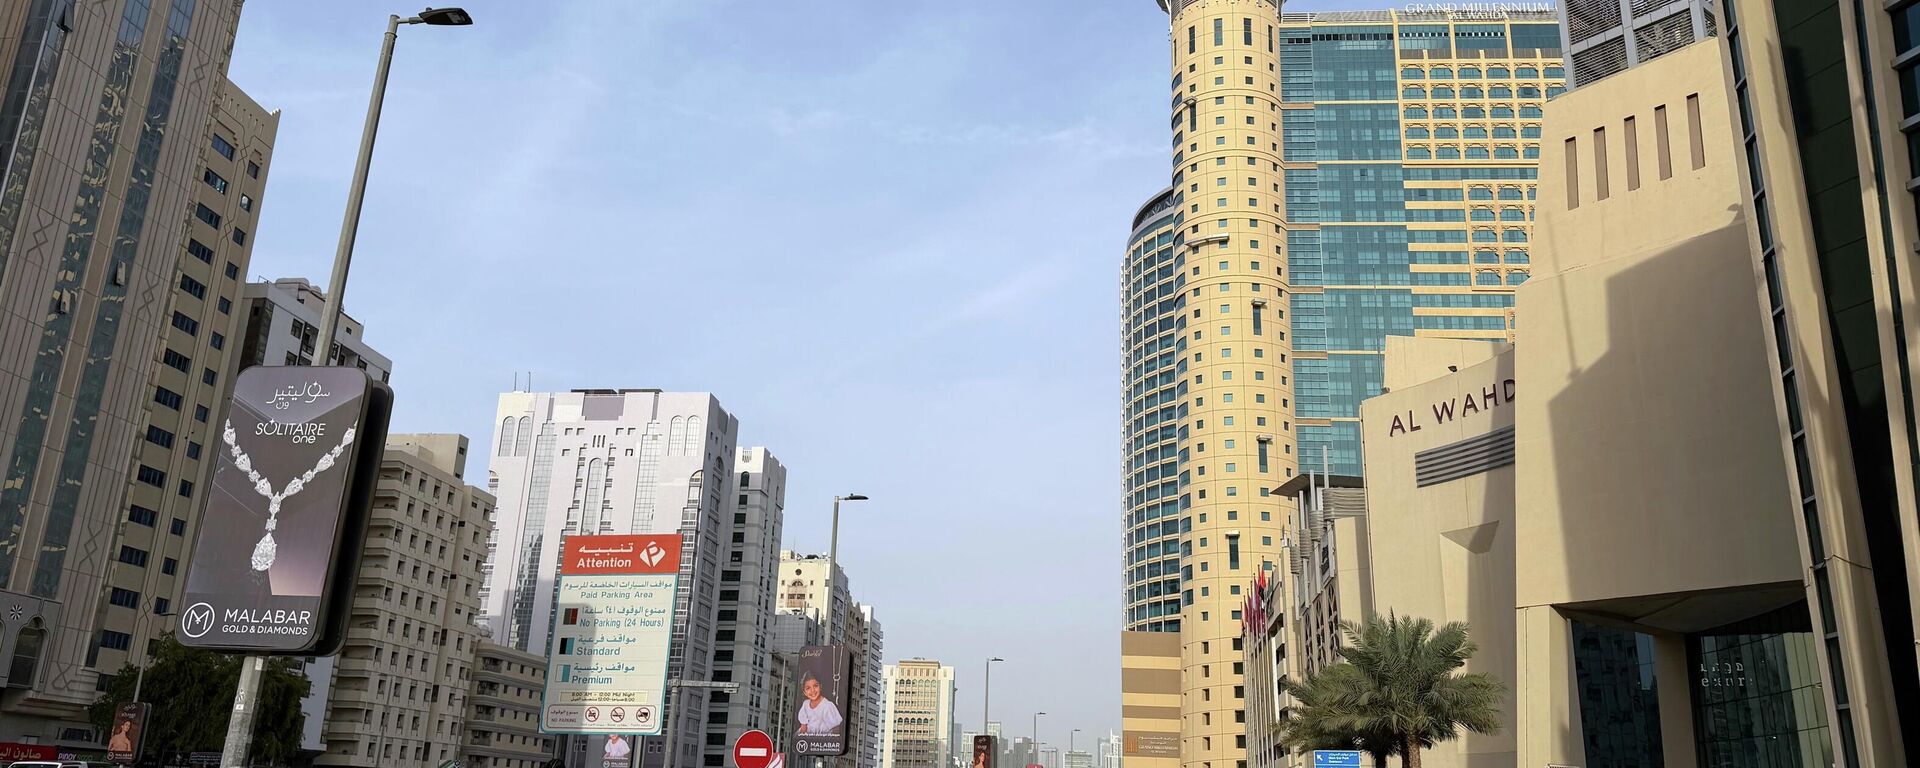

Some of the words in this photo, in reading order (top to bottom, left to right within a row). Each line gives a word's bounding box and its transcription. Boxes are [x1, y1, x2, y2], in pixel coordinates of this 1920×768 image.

[1405, 3, 1457, 14] GRAND
[1462, 2, 1550, 12] MILLENNIUM
[1466, 11, 1508, 20] WAHDA
[266, 381, 331, 404] سوليتير
[275, 401, 290, 410] ون
[255, 418, 326, 436] SOLITAIRE
[1390, 410, 1421, 437] AL
[292, 434, 316, 444] one
[578, 542, 634, 556] تنبيه
[576, 557, 632, 568] Attention
[564, 581, 588, 590] للرسوم
[589, 581, 618, 589] الخاضعة
[619, 581, 649, 590] السيارات
[649, 581, 672, 590] مواقف
[580, 591, 598, 599] Paid
[601, 591, 631, 599] Parking
[634, 591, 653, 599] Area
[617, 606, 643, 616] الوقوف
[644, 606, 666, 617] ممنوع
[224, 608, 311, 625] MALABAR
[579, 619, 590, 628] No
[593, 619, 621, 628] Parking
[624, 618, 636, 627] (24
[639, 618, 665, 628] Hours)
[222, 624, 249, 634] GOLD
[249, 626, 256, 634] &
[256, 625, 308, 635] DIAMONDS
[578, 635, 604, 645] فرعية
[606, 634, 636, 644] مواقف
[576, 647, 621, 656] Standard
[574, 663, 603, 673] رئيسية
[605, 663, 635, 673] مواقف
[571, 676, 612, 685] Premium
[13, 747, 42, 761] صالون
